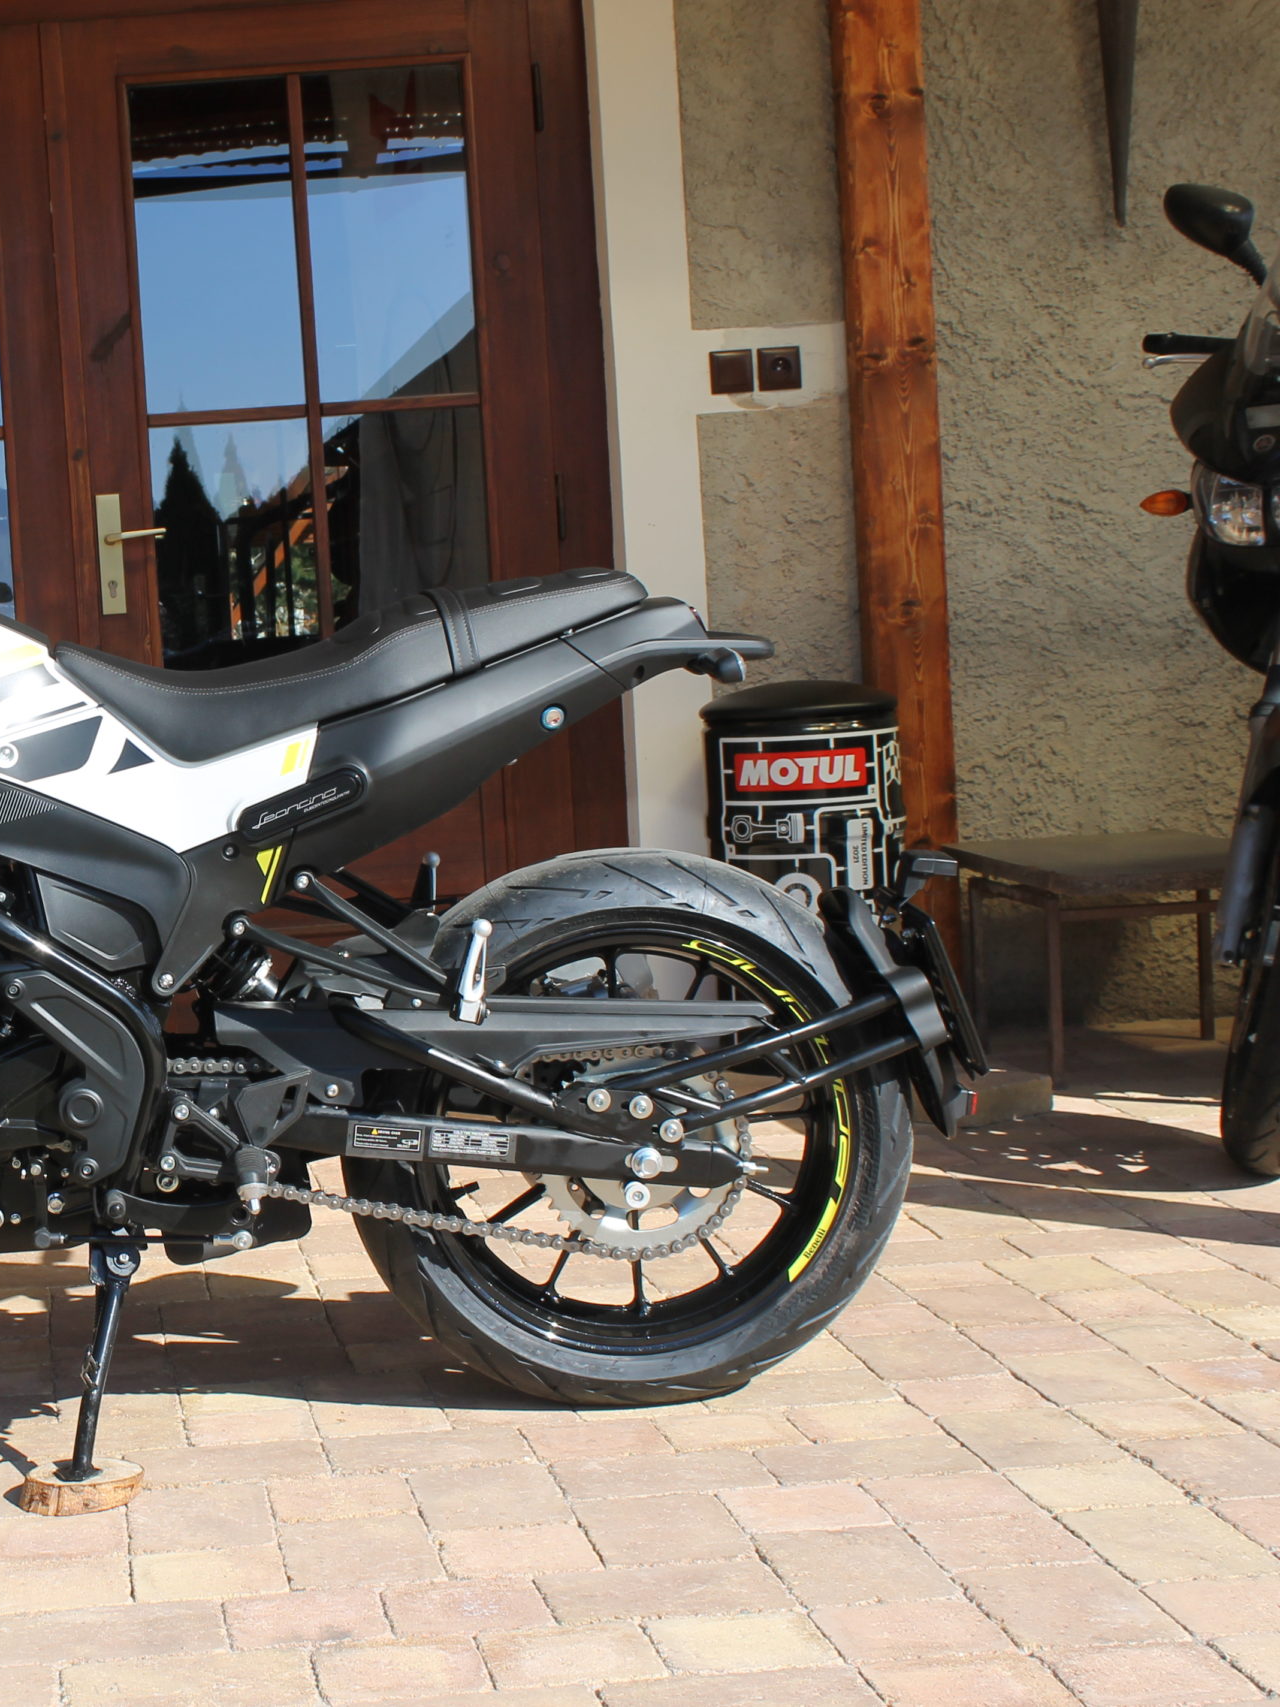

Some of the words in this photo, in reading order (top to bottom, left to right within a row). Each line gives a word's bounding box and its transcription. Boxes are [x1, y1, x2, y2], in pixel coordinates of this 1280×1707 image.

[738, 754, 861, 786] MOTUL
[861, 822, 869, 853] LIMITED
[861, 854, 870, 885] EDITION
[803, 1228, 826, 1259] Benelli
